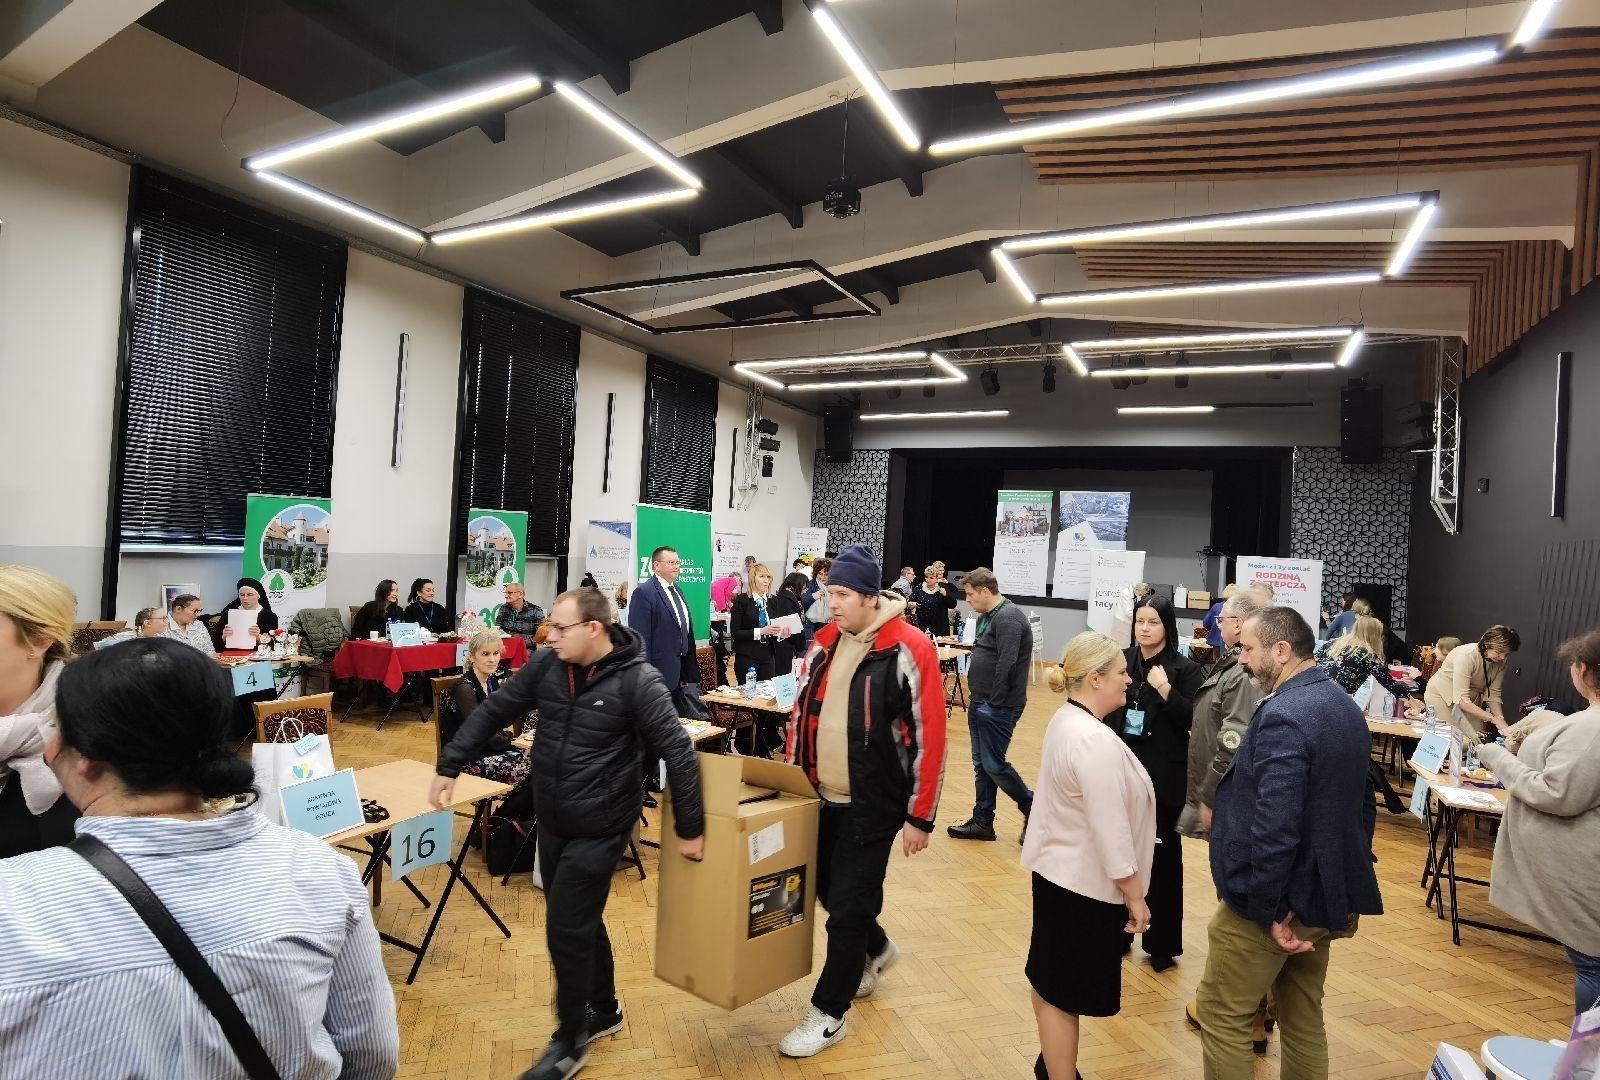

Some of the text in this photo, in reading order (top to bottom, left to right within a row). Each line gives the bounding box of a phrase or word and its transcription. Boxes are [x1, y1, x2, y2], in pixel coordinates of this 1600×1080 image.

[1255, 571, 1301, 582] RODZINĄ
[246, 671, 258, 687] 4
[401, 827, 436, 867] 16
